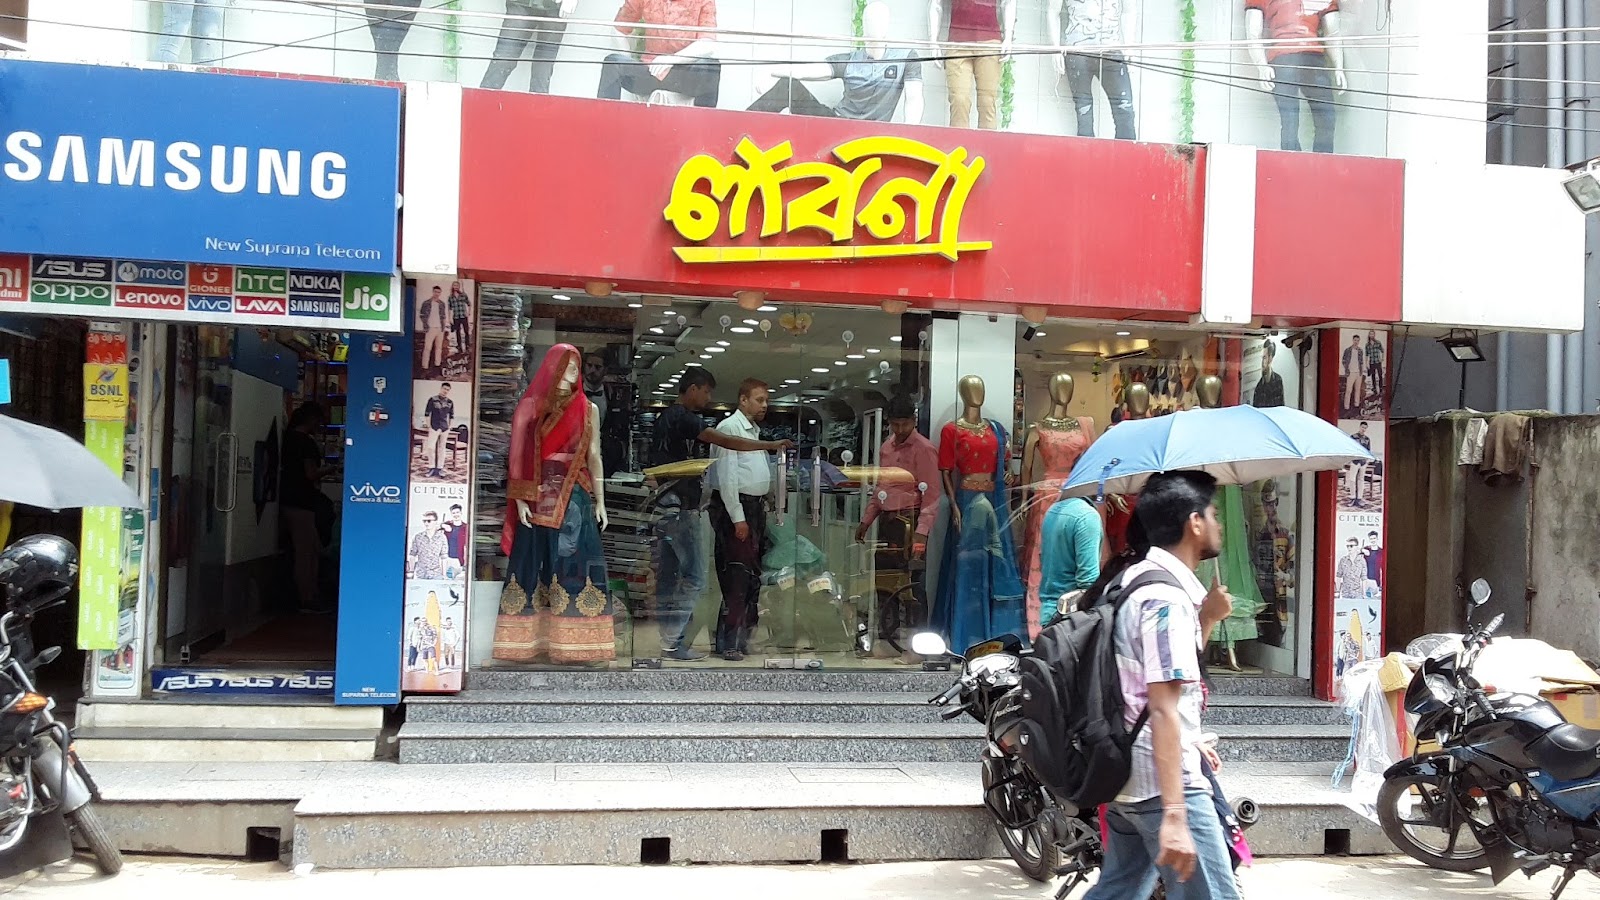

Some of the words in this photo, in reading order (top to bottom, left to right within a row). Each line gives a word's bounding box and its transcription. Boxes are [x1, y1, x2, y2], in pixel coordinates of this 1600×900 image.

[4, 130, 348, 200] SAMSUNG
[205, 237, 241, 251] New
[314, 243, 381, 260] Telecom
[35, 259, 106, 278] ASUS
[140, 267, 183, 281] moto
[189, 284, 231, 293] GIONEE
[290, 274, 341, 291] NOKIA
[115, 289, 182, 306] Lenovo
[344, 285, 388, 312] Jio
[236, 299, 285, 313] LAVA
[290, 299, 340, 314] SAMSUNG
[90, 384, 123, 396] BSNL
[413, 485, 465, 496] CITRUS
[1338, 514, 1380, 523] CITRUS
[159, 676, 213, 690] ASUS
[279, 676, 334, 689] ASUS
